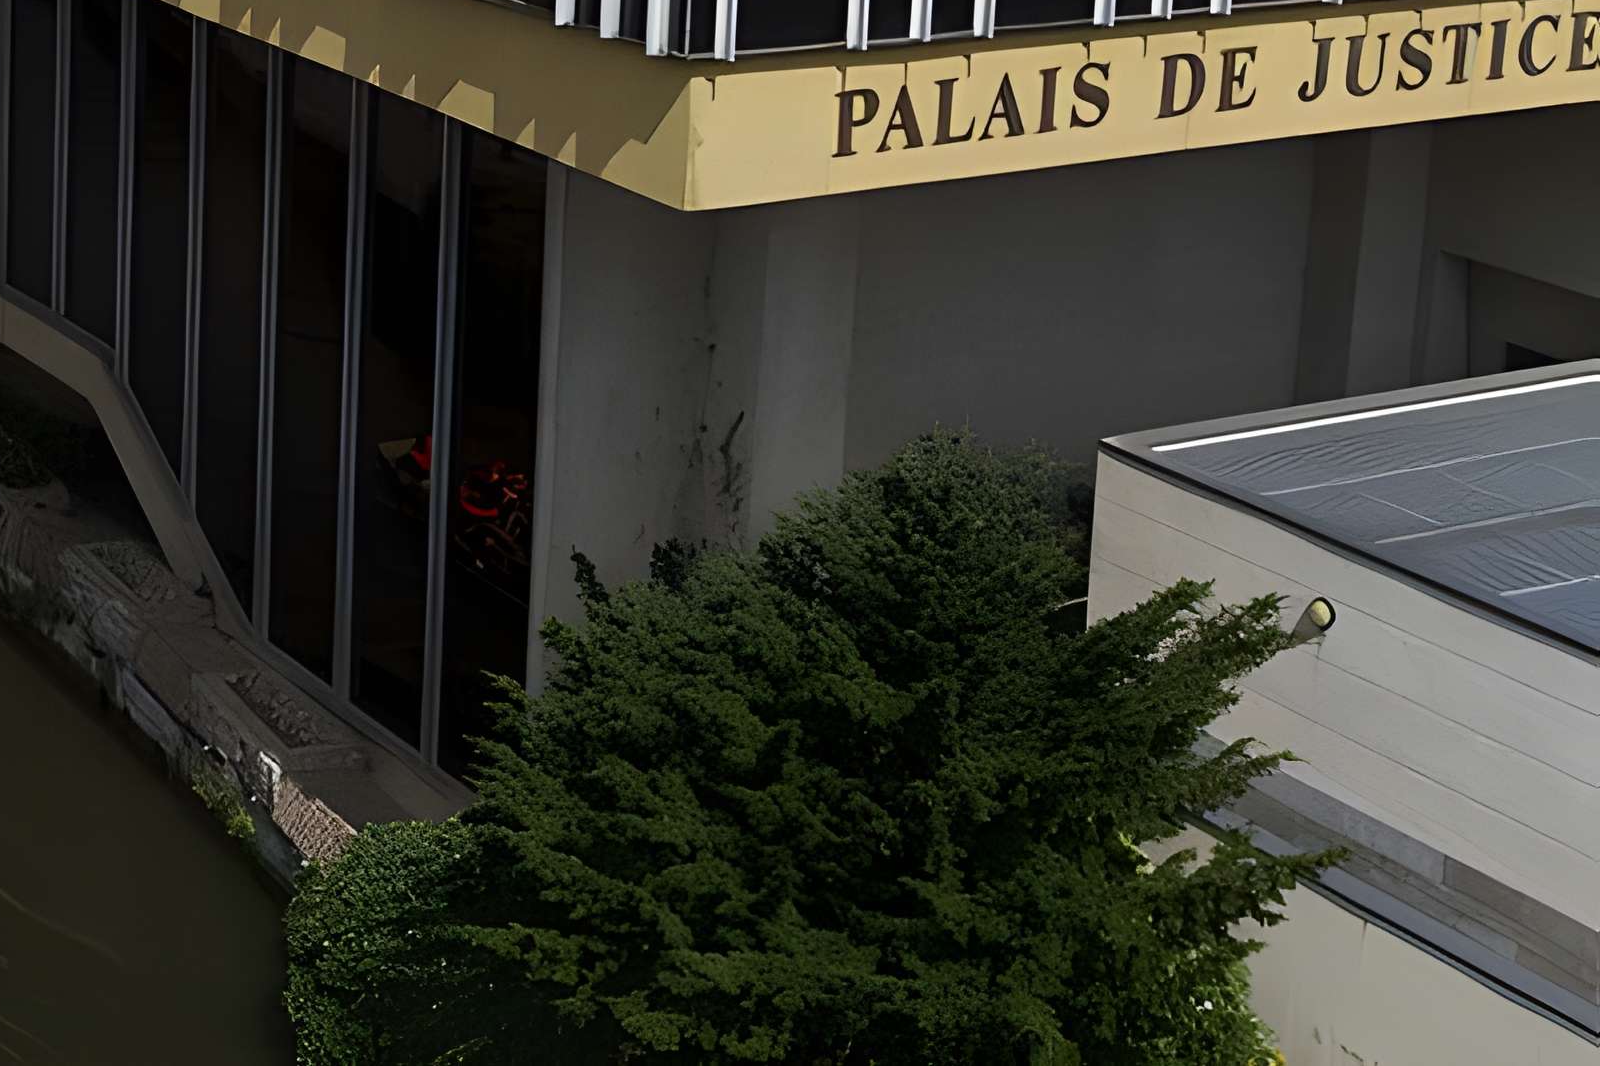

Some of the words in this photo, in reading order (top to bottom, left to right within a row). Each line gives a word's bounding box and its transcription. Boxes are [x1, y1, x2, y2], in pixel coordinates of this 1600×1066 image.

[831, 60, 1112, 158] PALAIS
[1153, 45, 1259, 120] DE
[1297, 10, 1600, 103] JUSTICE
